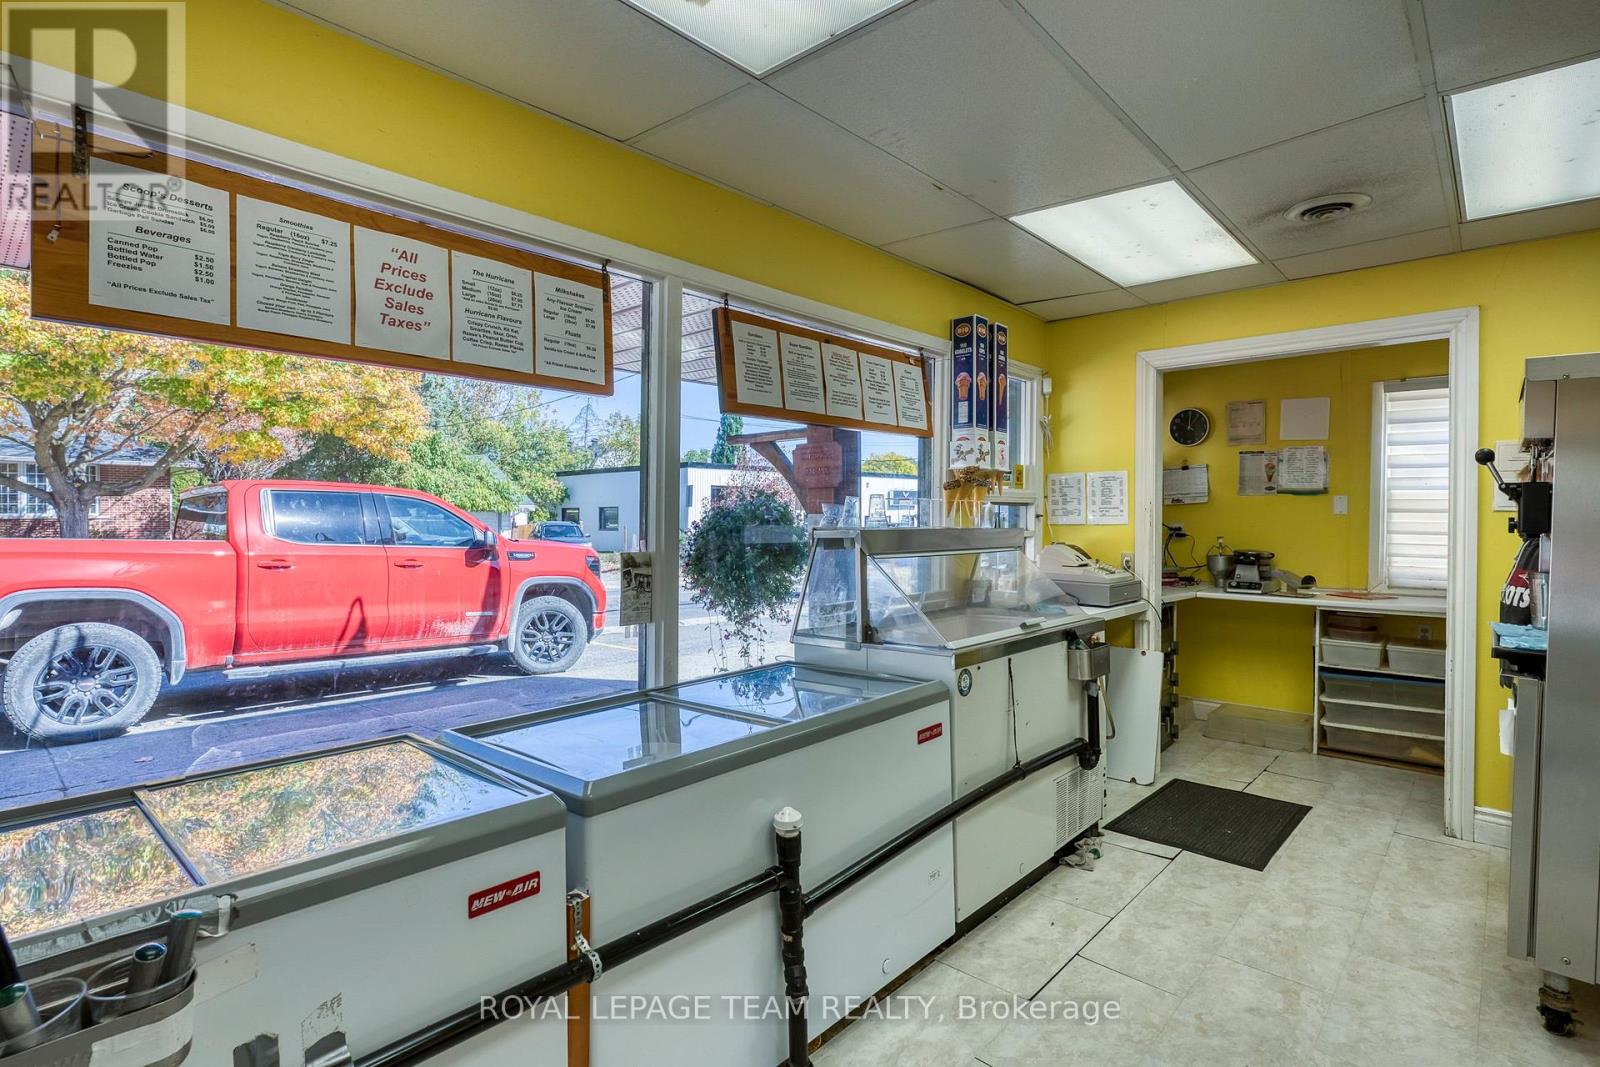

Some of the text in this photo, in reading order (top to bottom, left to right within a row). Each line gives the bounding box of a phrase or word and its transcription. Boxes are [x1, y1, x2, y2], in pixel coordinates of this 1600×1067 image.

[122, 183, 213, 211] Scoop's Desserts
[141, 209, 164, 218] Cookie
[166, 214, 195, 224] Sandwich
[151, 216, 174, 225] Sundae
[279, 217, 313, 230] Smoothies
[135, 226, 192, 244] Beverages
[256, 224, 283, 234] Regular
[321, 239, 338, 247] $7.25
[107, 237, 214, 263] Canned Pop $2.50
[107, 245, 214, 270] Bottled Water $1.50
[107, 252, 137, 263] Bottled
[194, 269, 213, 277] $2.50
[107, 260, 214, 285] Freezies $1.00
[381, 263, 427, 283] Prices
[486, 272, 514, 284] Hurricane
[124, 284, 147, 293] Prices
[149, 288, 177, 298] Exclude
[374, 278, 433, 300] Exclude
[555, 287, 584, 299] Milkshakes
[385, 298, 424, 315] Sales
[465, 308, 522, 324] Hurricane Flavours
[565, 330, 581, 338] Floats
